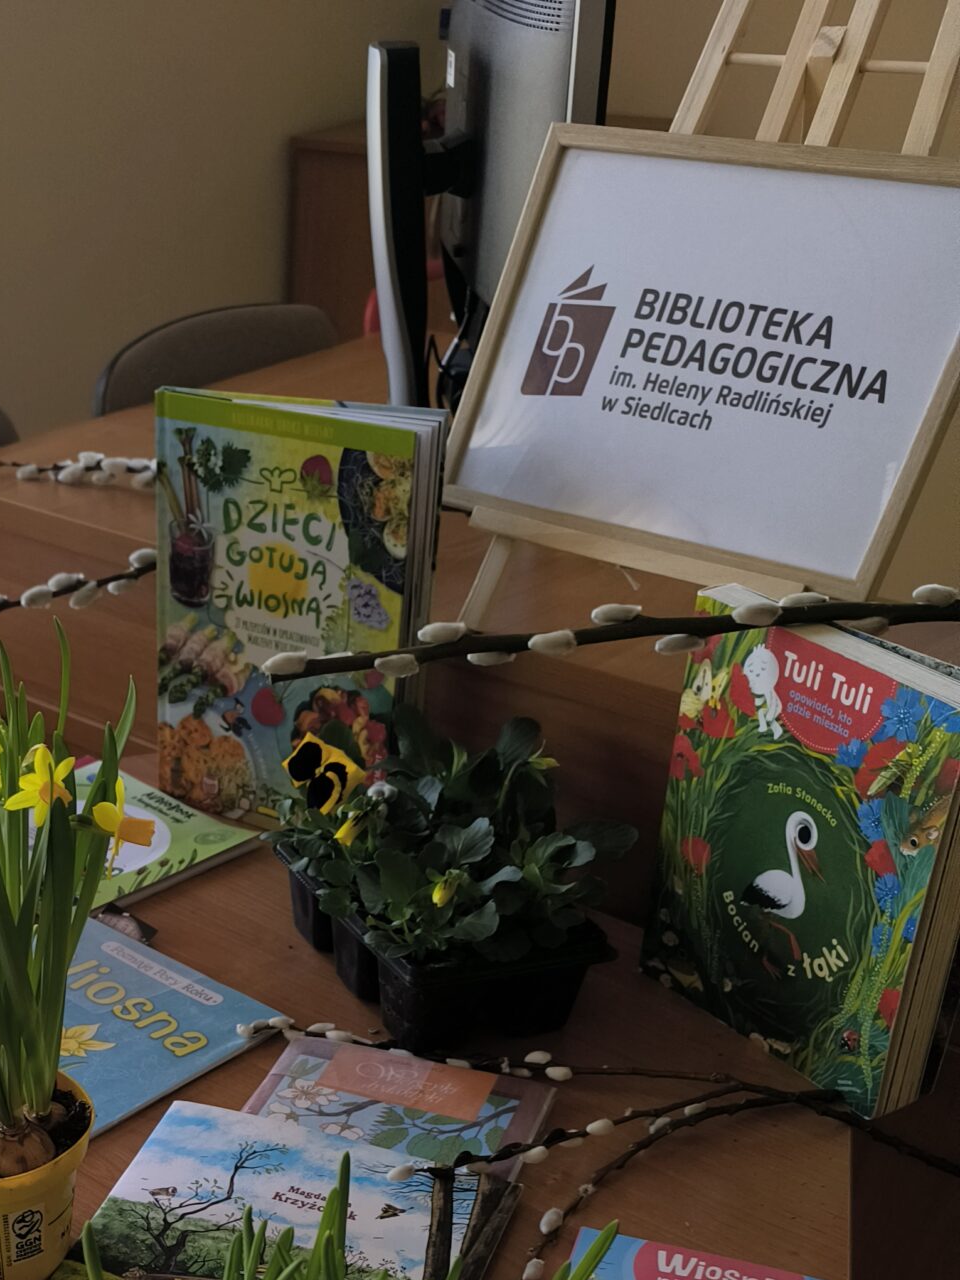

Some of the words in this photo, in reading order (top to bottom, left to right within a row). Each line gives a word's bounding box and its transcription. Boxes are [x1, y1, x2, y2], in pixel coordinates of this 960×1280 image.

[634, 288, 834, 349] BIBLIOTEKA
[619, 328, 888, 403] PEDAGOGICZNA
[601, 395, 618, 412] w
[621, 396, 713, 431] Siedlcach
[609, 366, 637, 389] im.
[643, 375, 713, 406] Heleny
[716, 385, 833, 429] Radlińskiej
[222, 498, 336, 552] DZIECI
[225, 541, 327, 591] GOTUJĄ
[236, 580, 321, 629] WIOSNĄ
[784, 650, 824, 691] Tuli
[832, 672, 874, 715] Tuli
[813, 715, 850, 738] mieszka
[767, 782, 793, 796] Zofia
[795, 787, 838, 828] Stanecka
[722, 889, 760, 953] Bocian
[786, 963, 796, 977] z
[803, 938, 849, 983] łąki
[181, 981, 215, 1005] Roku
[271, 1190, 358, 1221] Krzyżk
[287, 1184, 352, 1209] Magdaa
